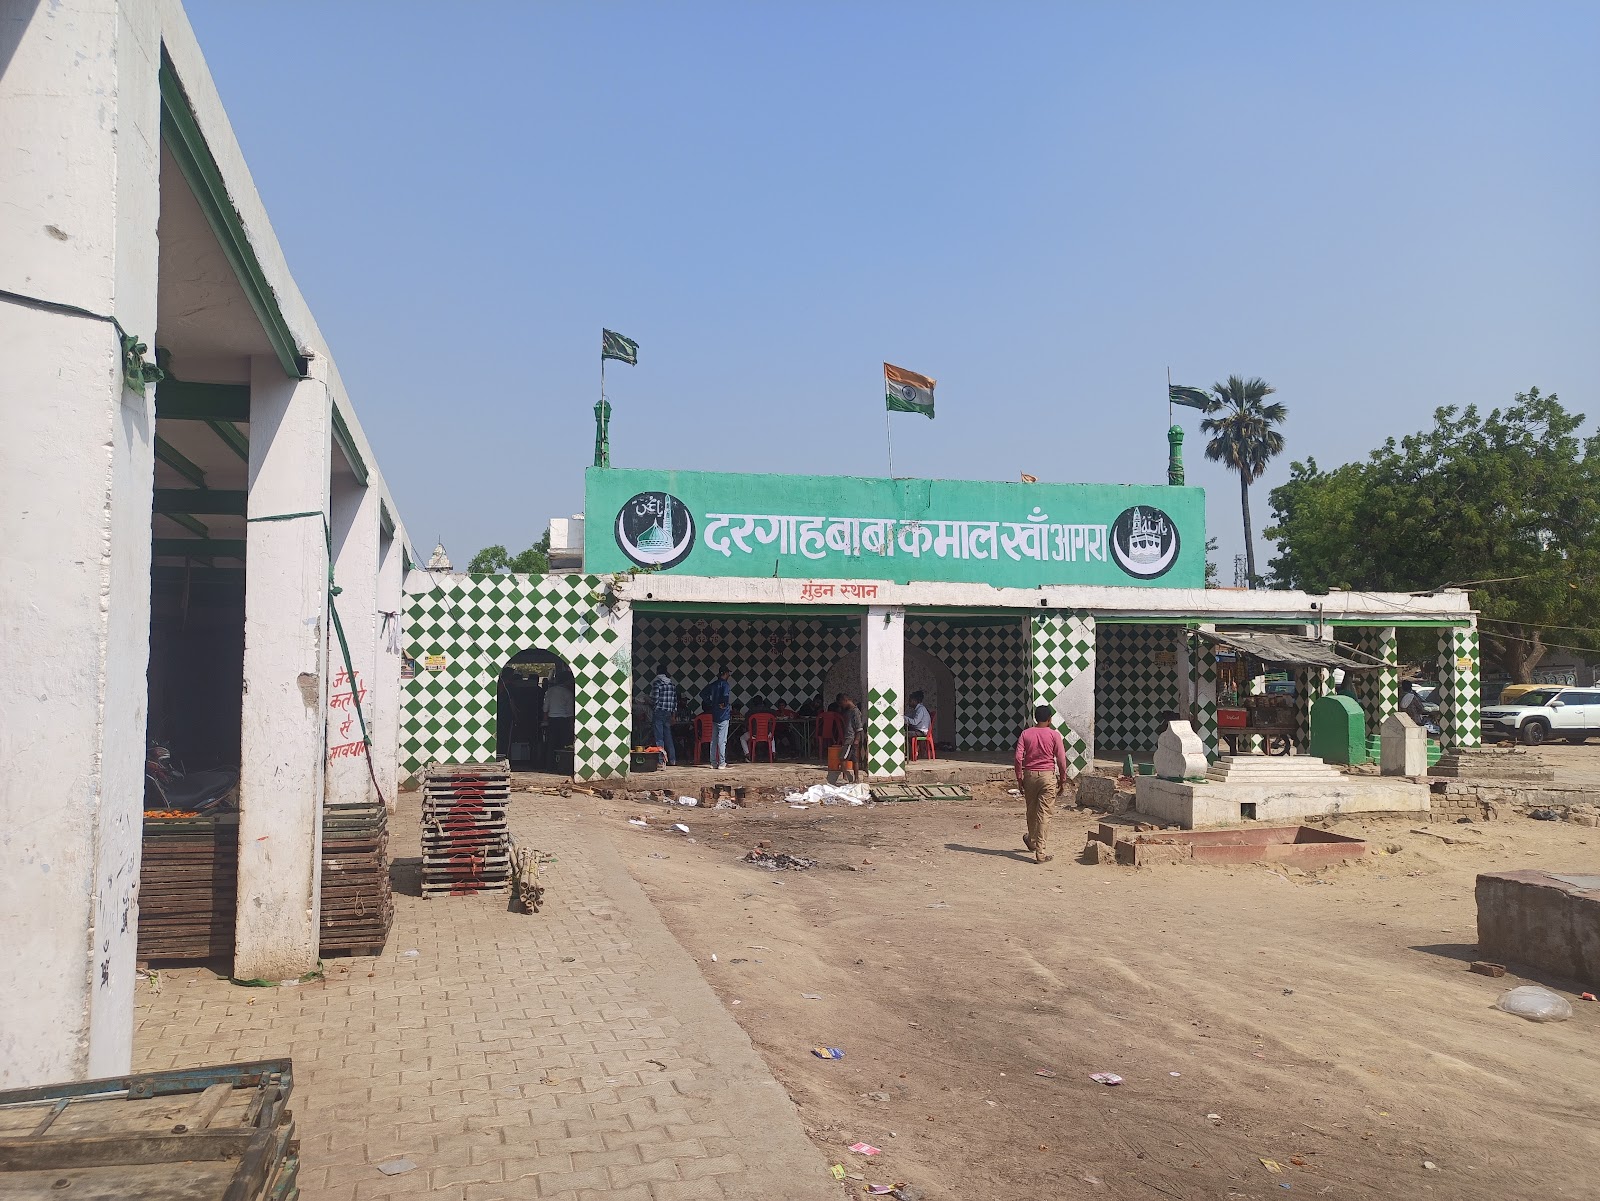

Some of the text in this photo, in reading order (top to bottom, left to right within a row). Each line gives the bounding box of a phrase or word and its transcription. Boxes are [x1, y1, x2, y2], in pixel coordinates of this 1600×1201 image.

[704, 513, 826, 560] दरगाह
[825, 517, 896, 558] बाबा
[897, 519, 999, 561] कमाल
[1051, 523, 1108, 563] आगरा
[801, 580, 878, 601] मुंडन स्थान
[340, 713, 354, 739] से
